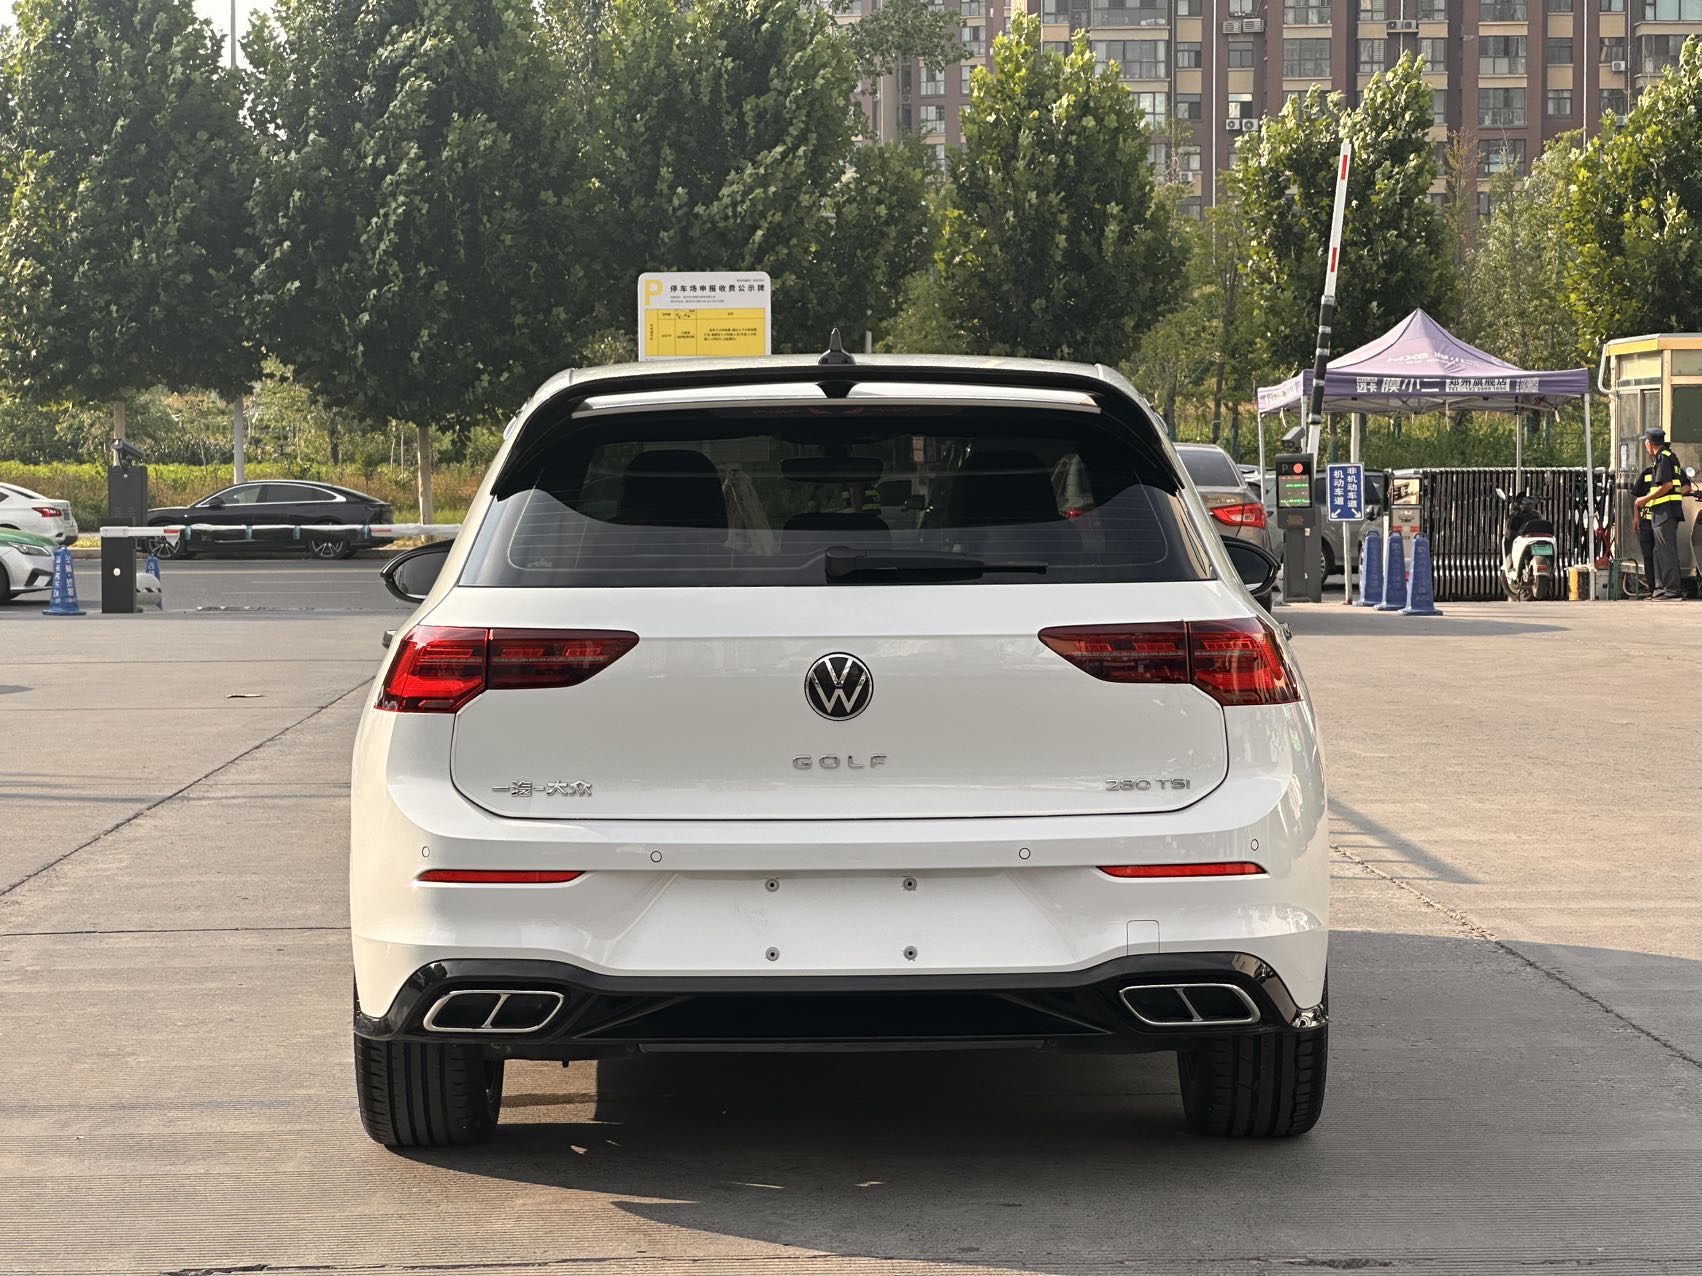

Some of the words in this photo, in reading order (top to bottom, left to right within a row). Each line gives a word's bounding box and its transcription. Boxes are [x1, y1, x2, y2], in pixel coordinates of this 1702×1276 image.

[645, 279, 663, 305] P
[670, 284, 765, 293] 停车场申报收费公示牌
[1356, 382, 1378, 393] 迈卡
[1381, 378, 1440, 393] 膜小二
[1448, 378, 1507, 387] 郑州旗舰店
[1333, 470, 1345, 505] 机动车道
[1347, 467, 1358, 508] 非机动车道
[792, 755, 888, 770] GOLF
[492, 780, 592, 798] 一汽-大众
[1105, 779, 1151, 792] 280
[1155, 778, 1191, 790] TSI
